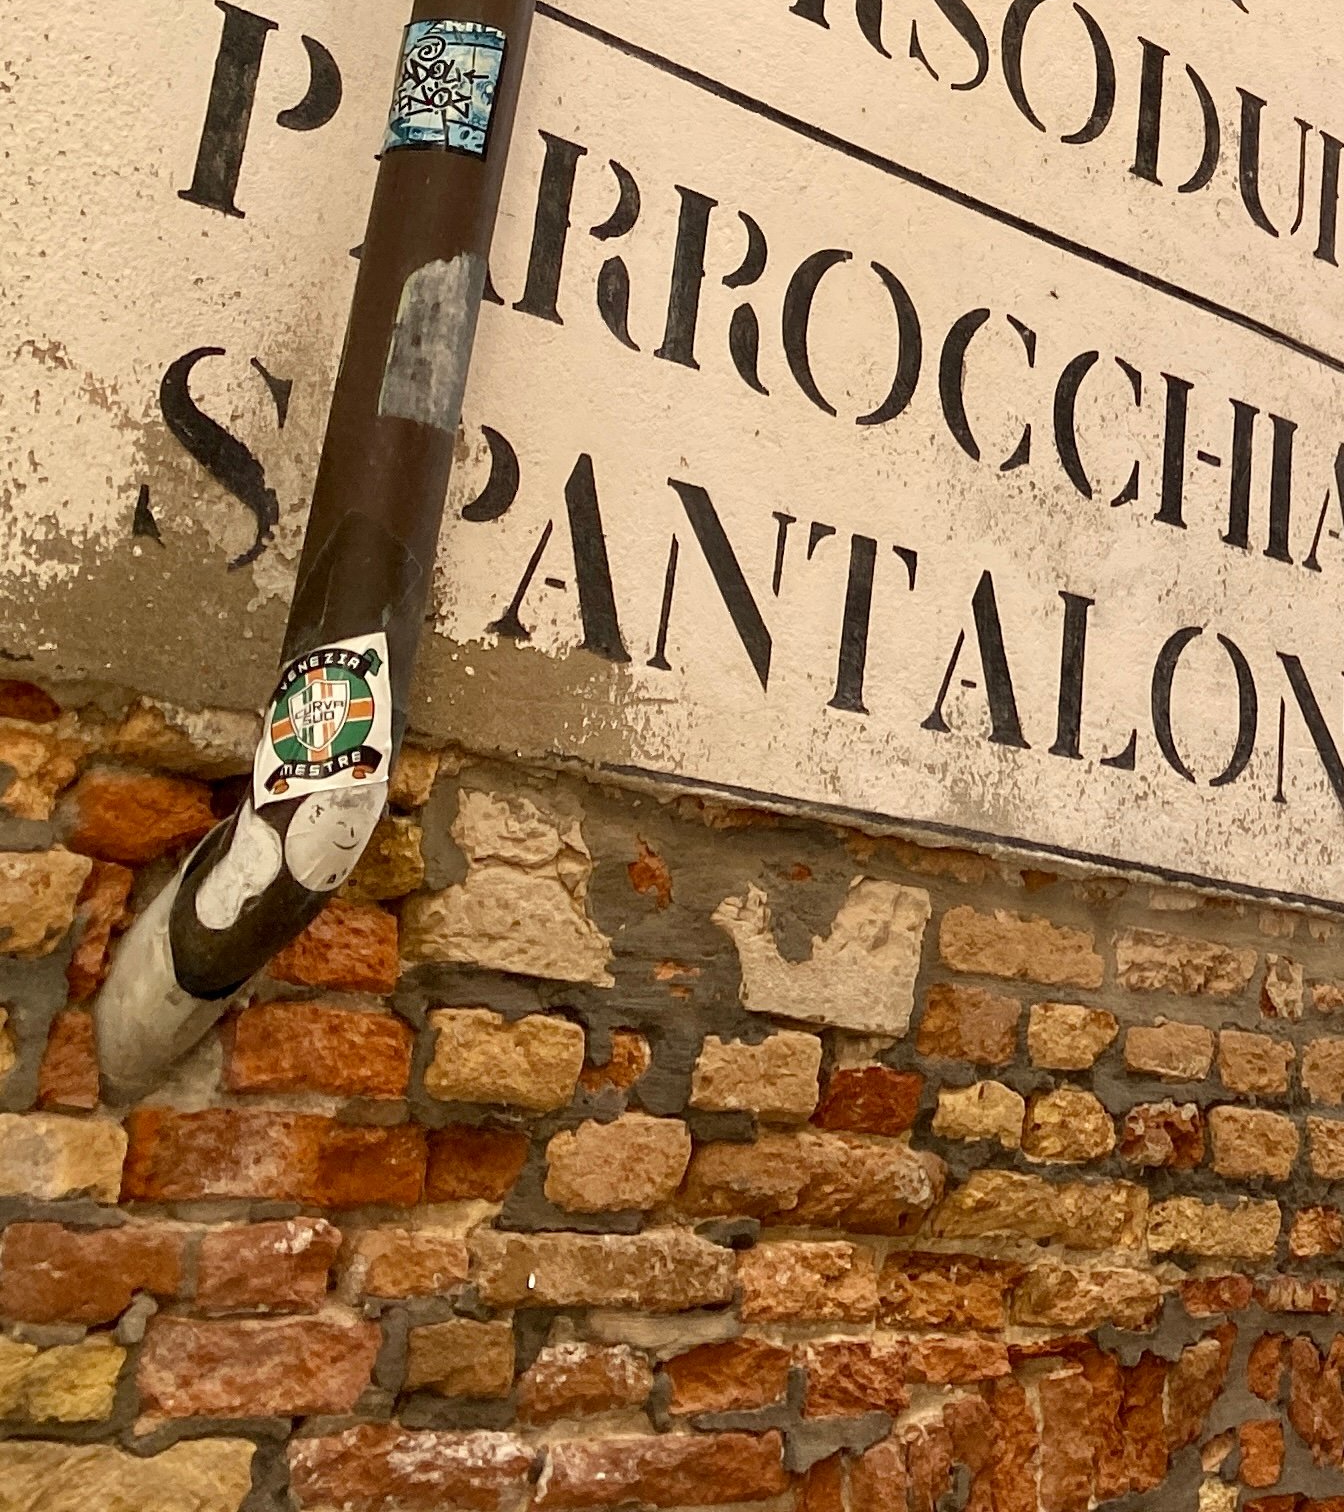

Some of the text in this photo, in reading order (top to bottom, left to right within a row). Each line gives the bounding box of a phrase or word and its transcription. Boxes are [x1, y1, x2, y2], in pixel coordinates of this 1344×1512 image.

[281, 653, 360, 690] VENEZIA
[295, 700, 344, 719] CURVA
[302, 711, 334, 726] SUD
[280, 750, 361, 776] MESTRE
